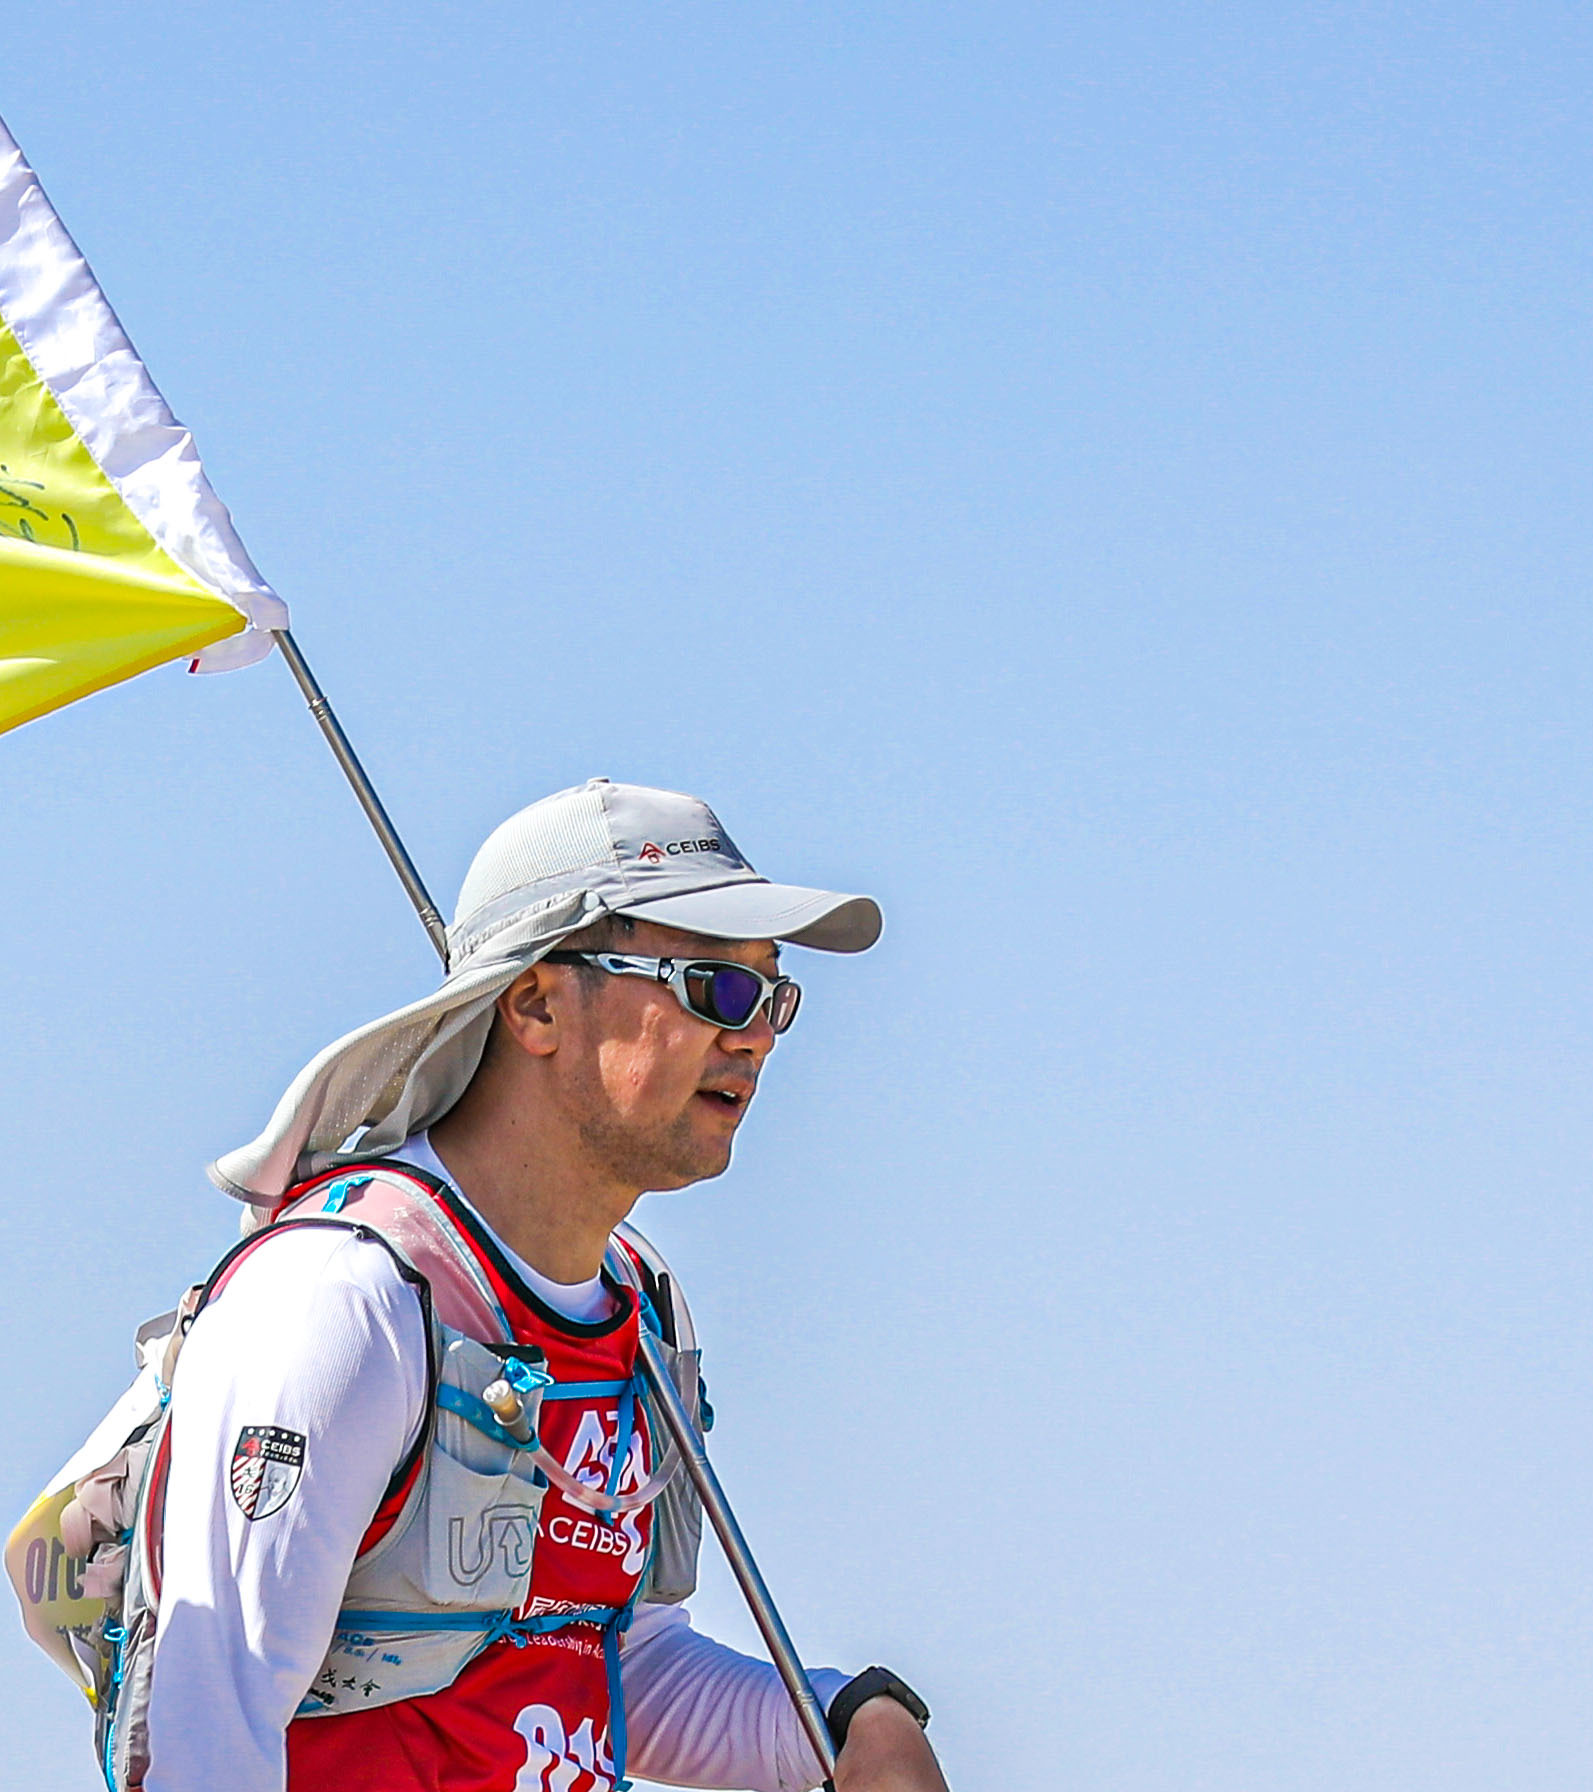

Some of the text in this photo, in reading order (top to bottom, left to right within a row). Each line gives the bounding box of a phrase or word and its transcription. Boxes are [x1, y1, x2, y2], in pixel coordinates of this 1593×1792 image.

[665, 838, 721, 857] CEIBS
[261, 1438, 301, 1457] CEIBS
[549, 1516, 628, 1557] CEIBS
